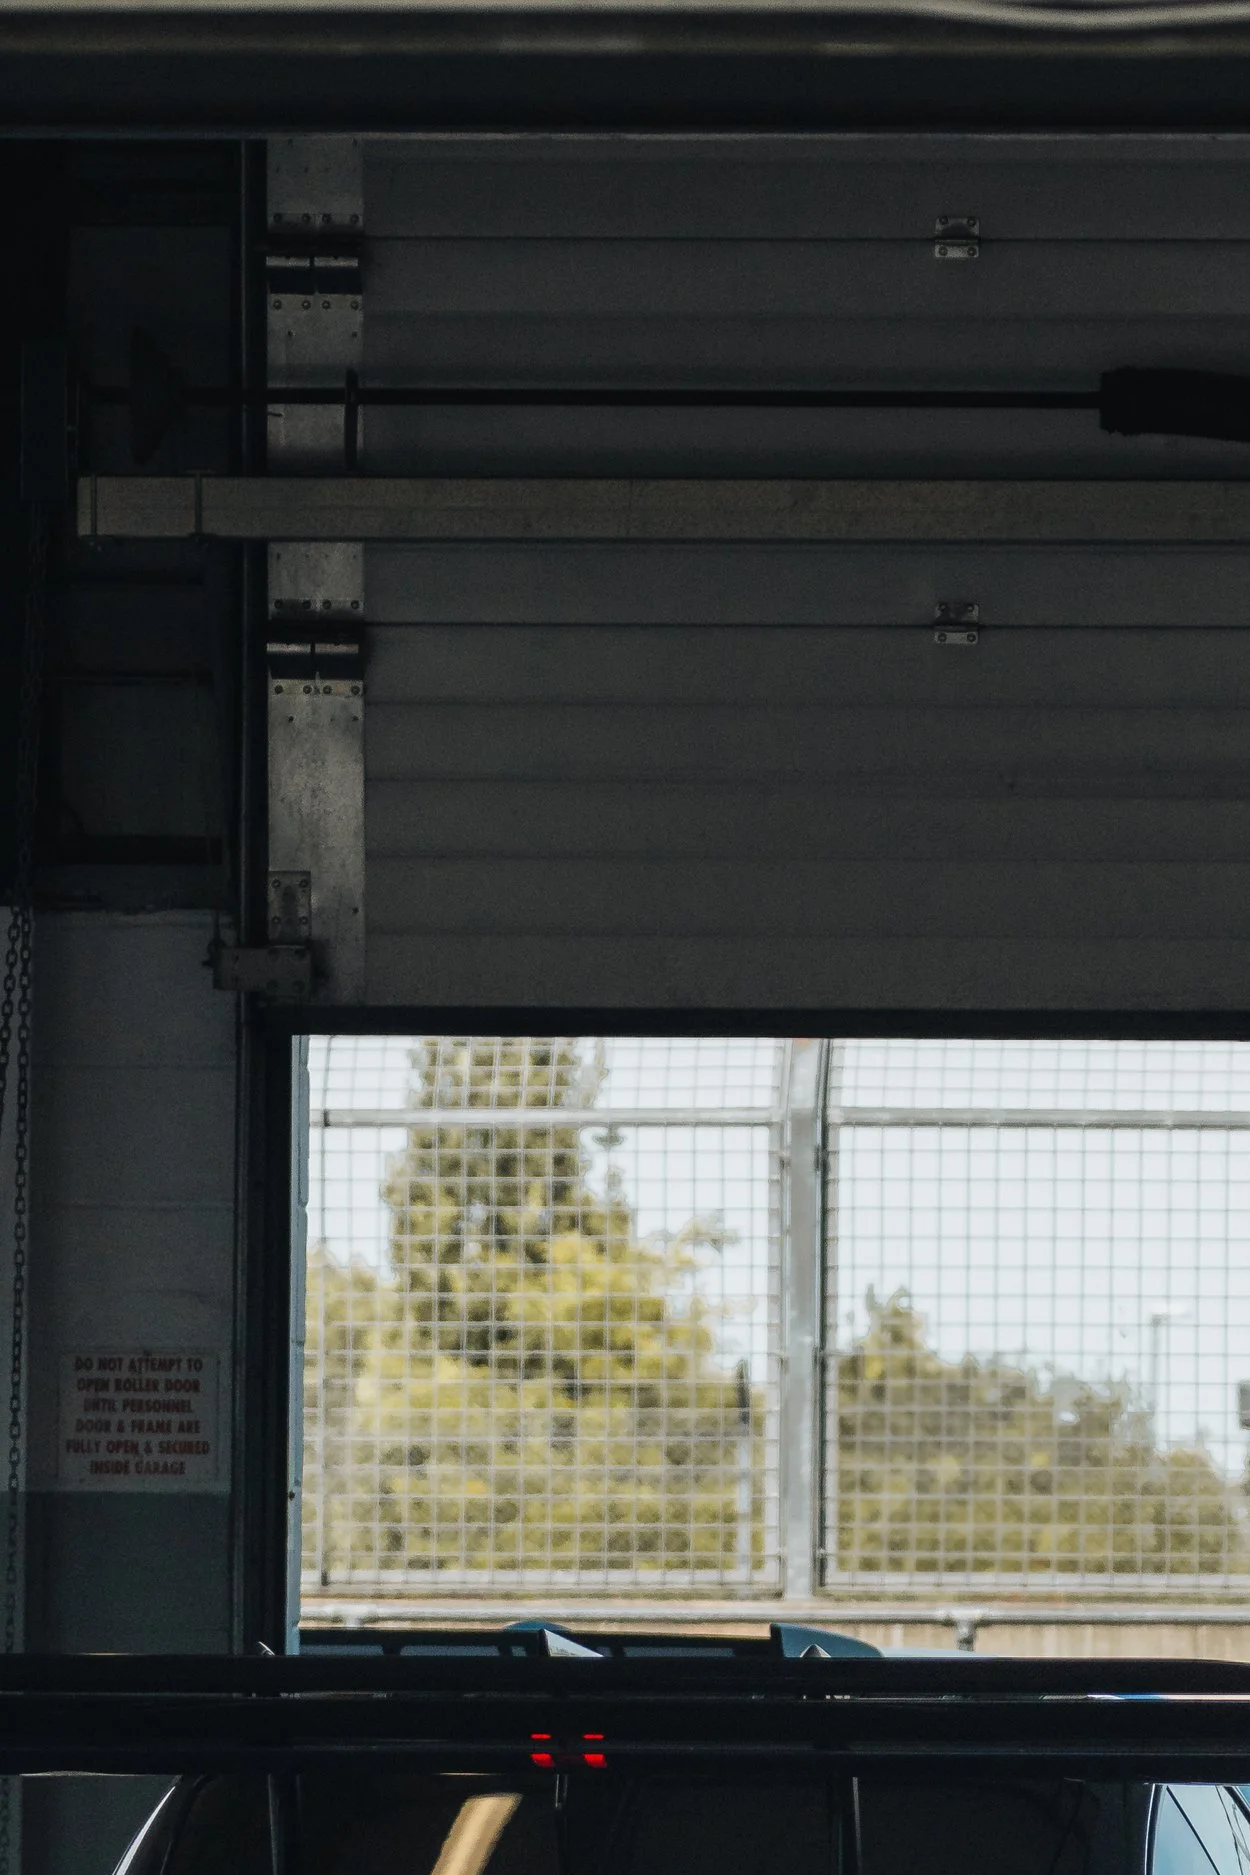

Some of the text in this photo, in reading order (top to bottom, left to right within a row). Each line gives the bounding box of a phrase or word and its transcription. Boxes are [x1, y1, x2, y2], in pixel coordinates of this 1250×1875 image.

[75, 1357, 203, 1372] DO NOT ATTEMPT TO
[77, 1378, 200, 1392] OPEN ROLLER DOOR
[84, 1399, 193, 1413] UNTIL PERSONNEL
[76, 1419, 111, 1433] DOOR
[131, 1420, 172, 1433] FRAME
[178, 1420, 200, 1433] ARE
[66, 1439, 101, 1453] FULLY
[107, 1440, 139, 1453] OPEN
[158, 1441, 210, 1454] SECURED
[90, 1460, 186, 1475] INSIDE GARAGE
